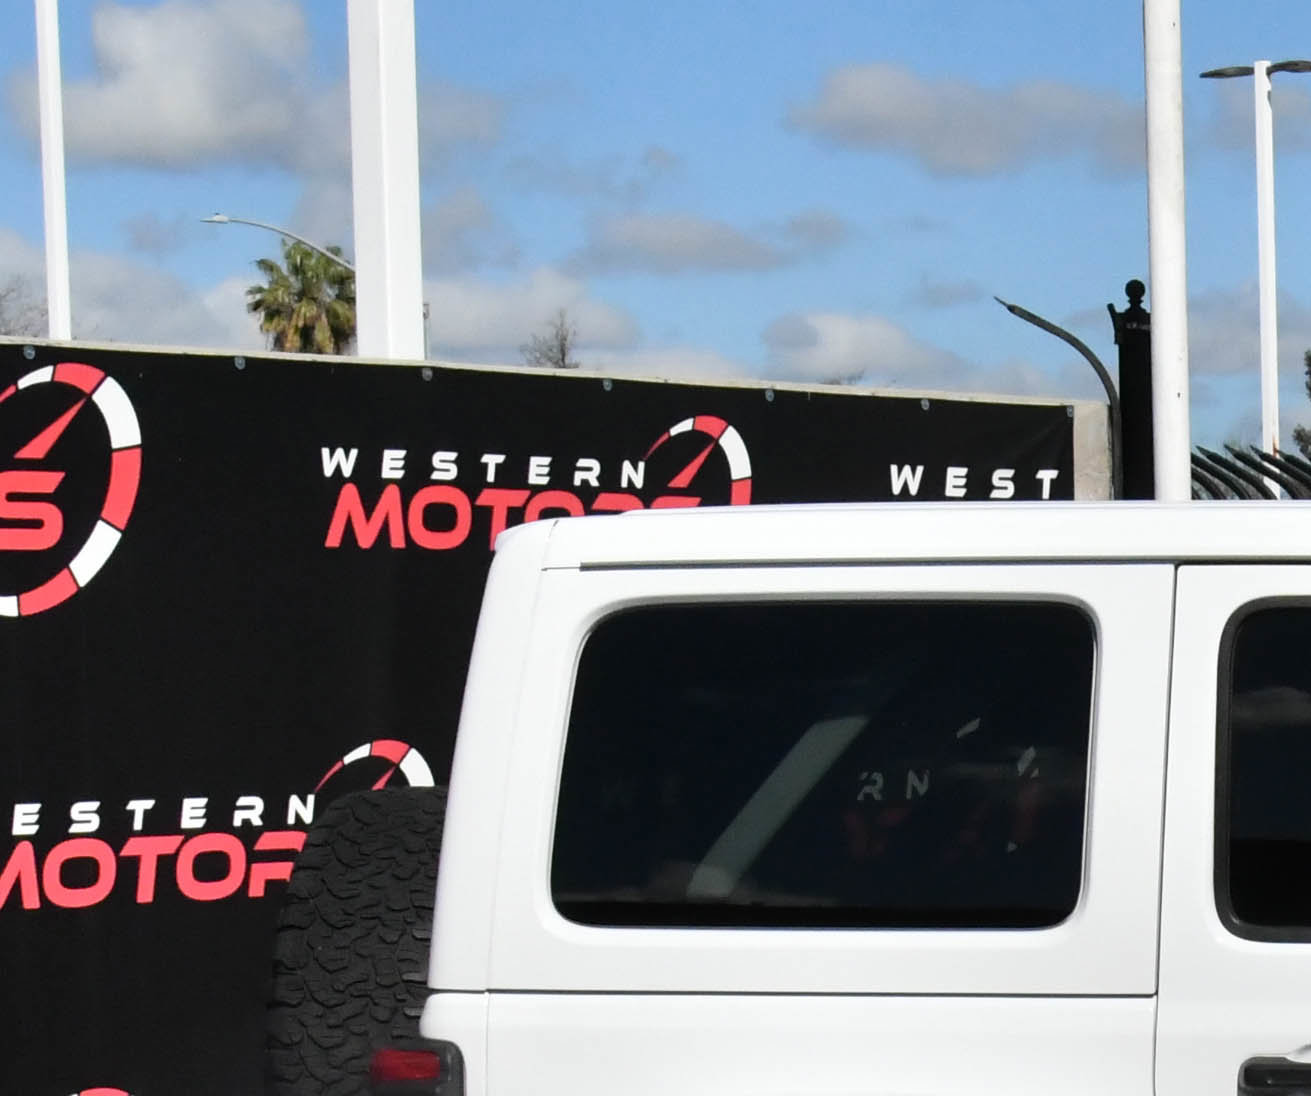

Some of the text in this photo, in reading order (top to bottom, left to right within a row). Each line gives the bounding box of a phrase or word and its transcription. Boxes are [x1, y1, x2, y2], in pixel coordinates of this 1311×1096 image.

[321, 447, 645, 489] WESTERN
[890, 464, 1060, 500] WEST
[12, 794, 316, 836] ESTERN
